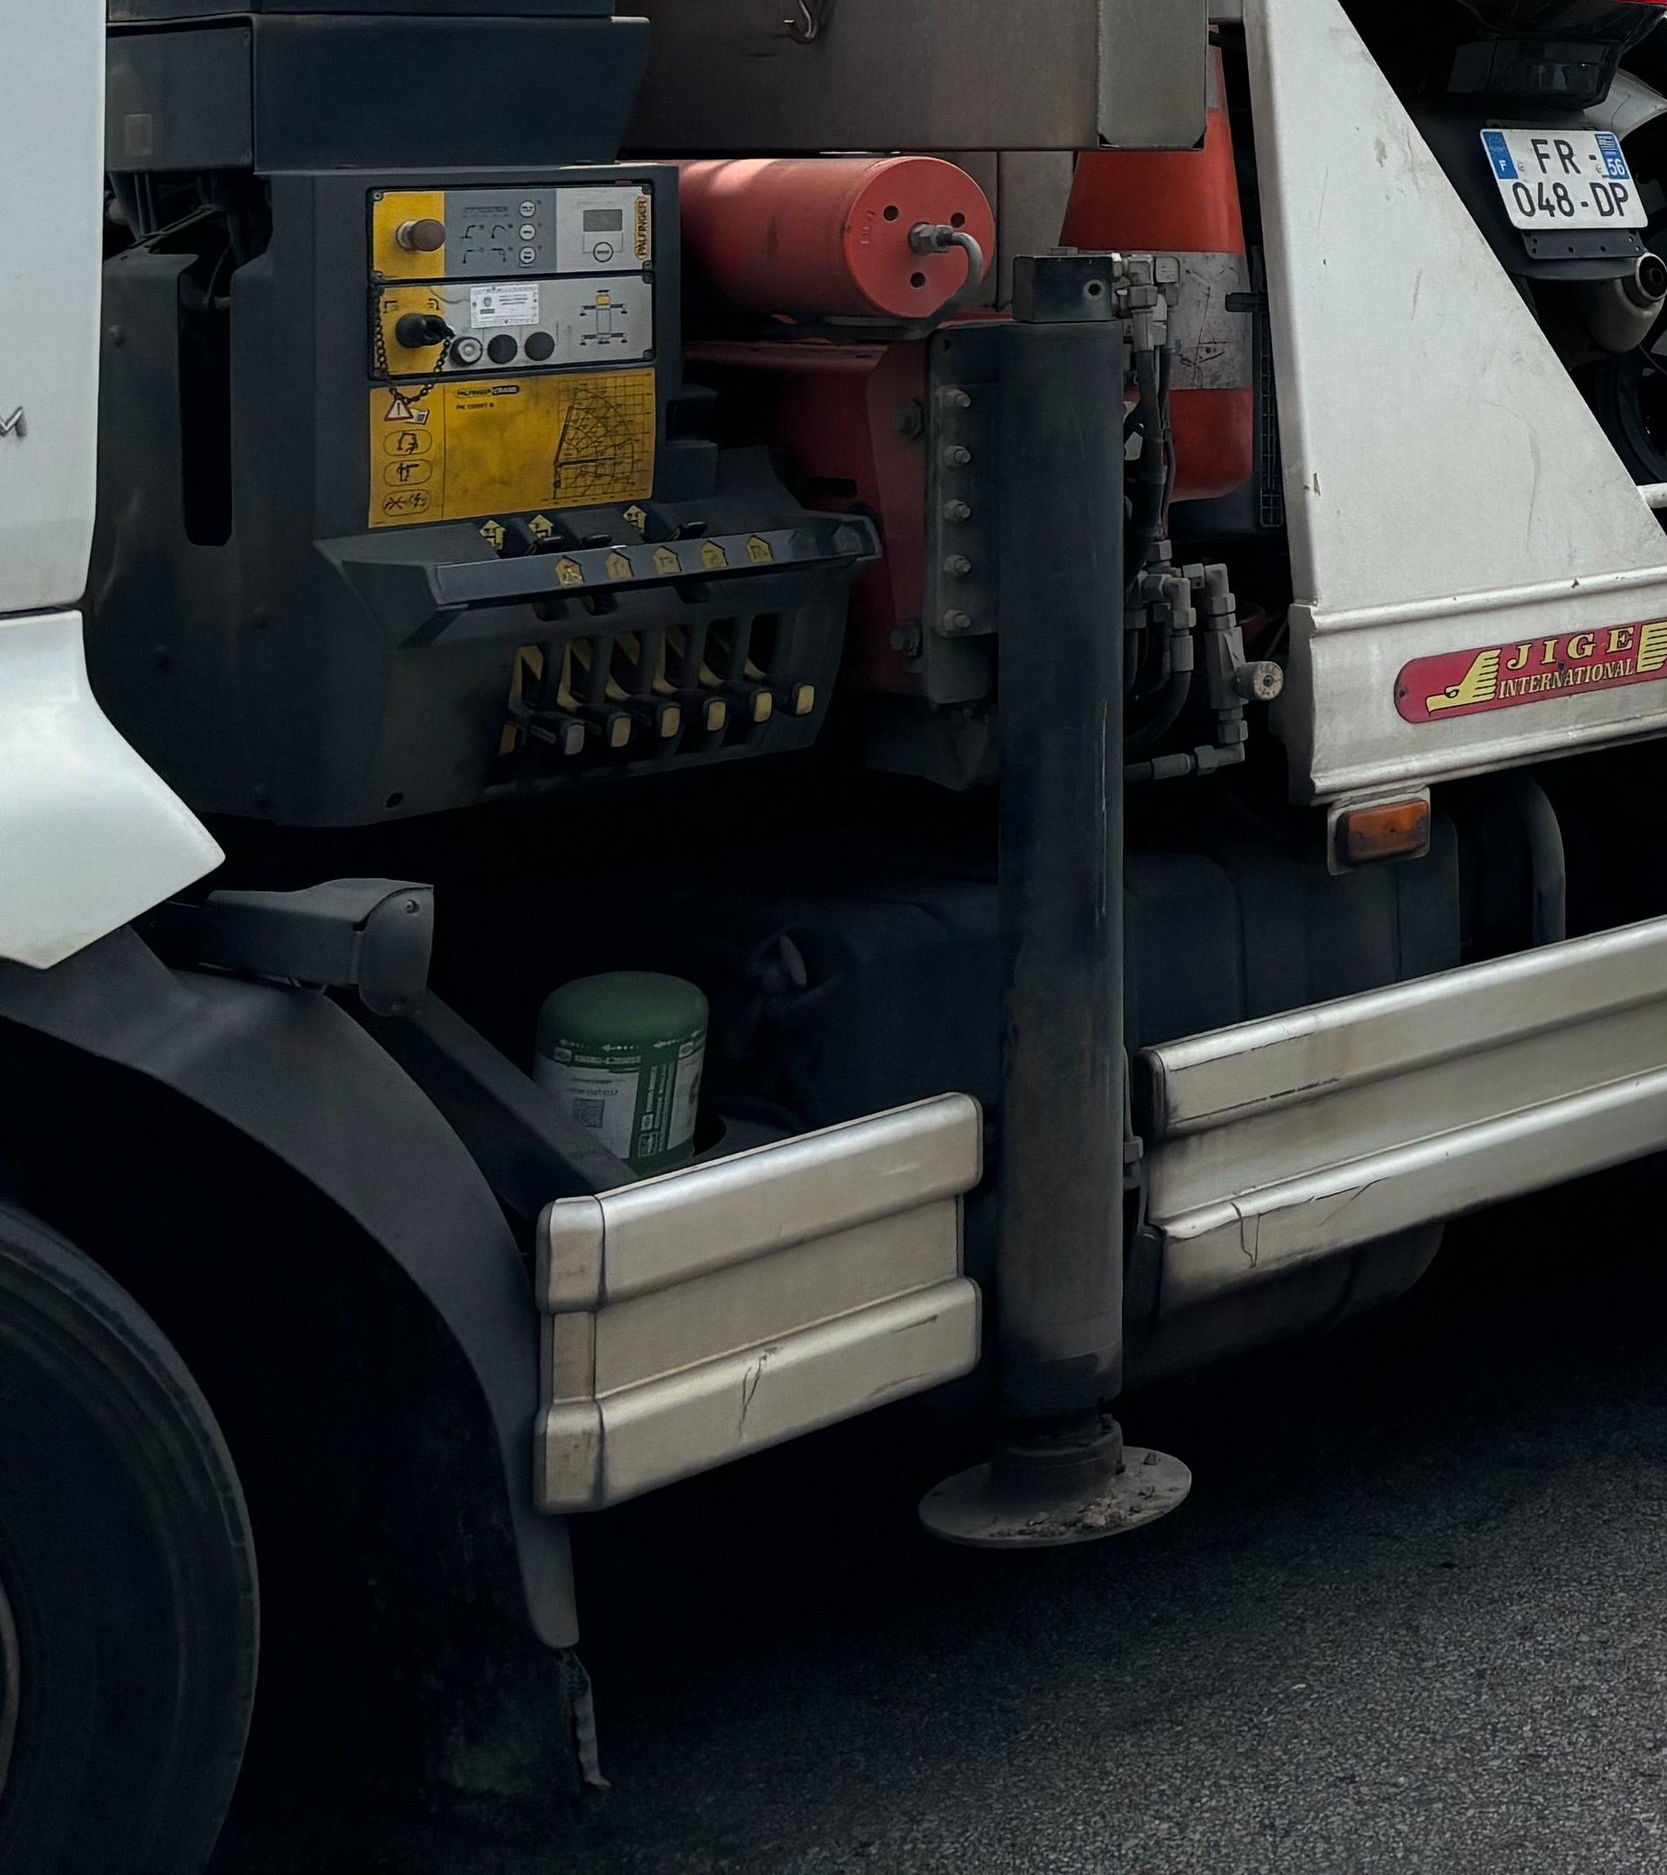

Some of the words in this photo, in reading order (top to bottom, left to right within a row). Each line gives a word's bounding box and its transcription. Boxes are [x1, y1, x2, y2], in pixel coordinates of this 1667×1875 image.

[1607, 158, 1626, 176] 56
[1512, 182, 1629, 218] 048-DP
[1506, 626, 1635, 671] JIGE
[1498, 658, 1635, 699] INTERNATIONAL
